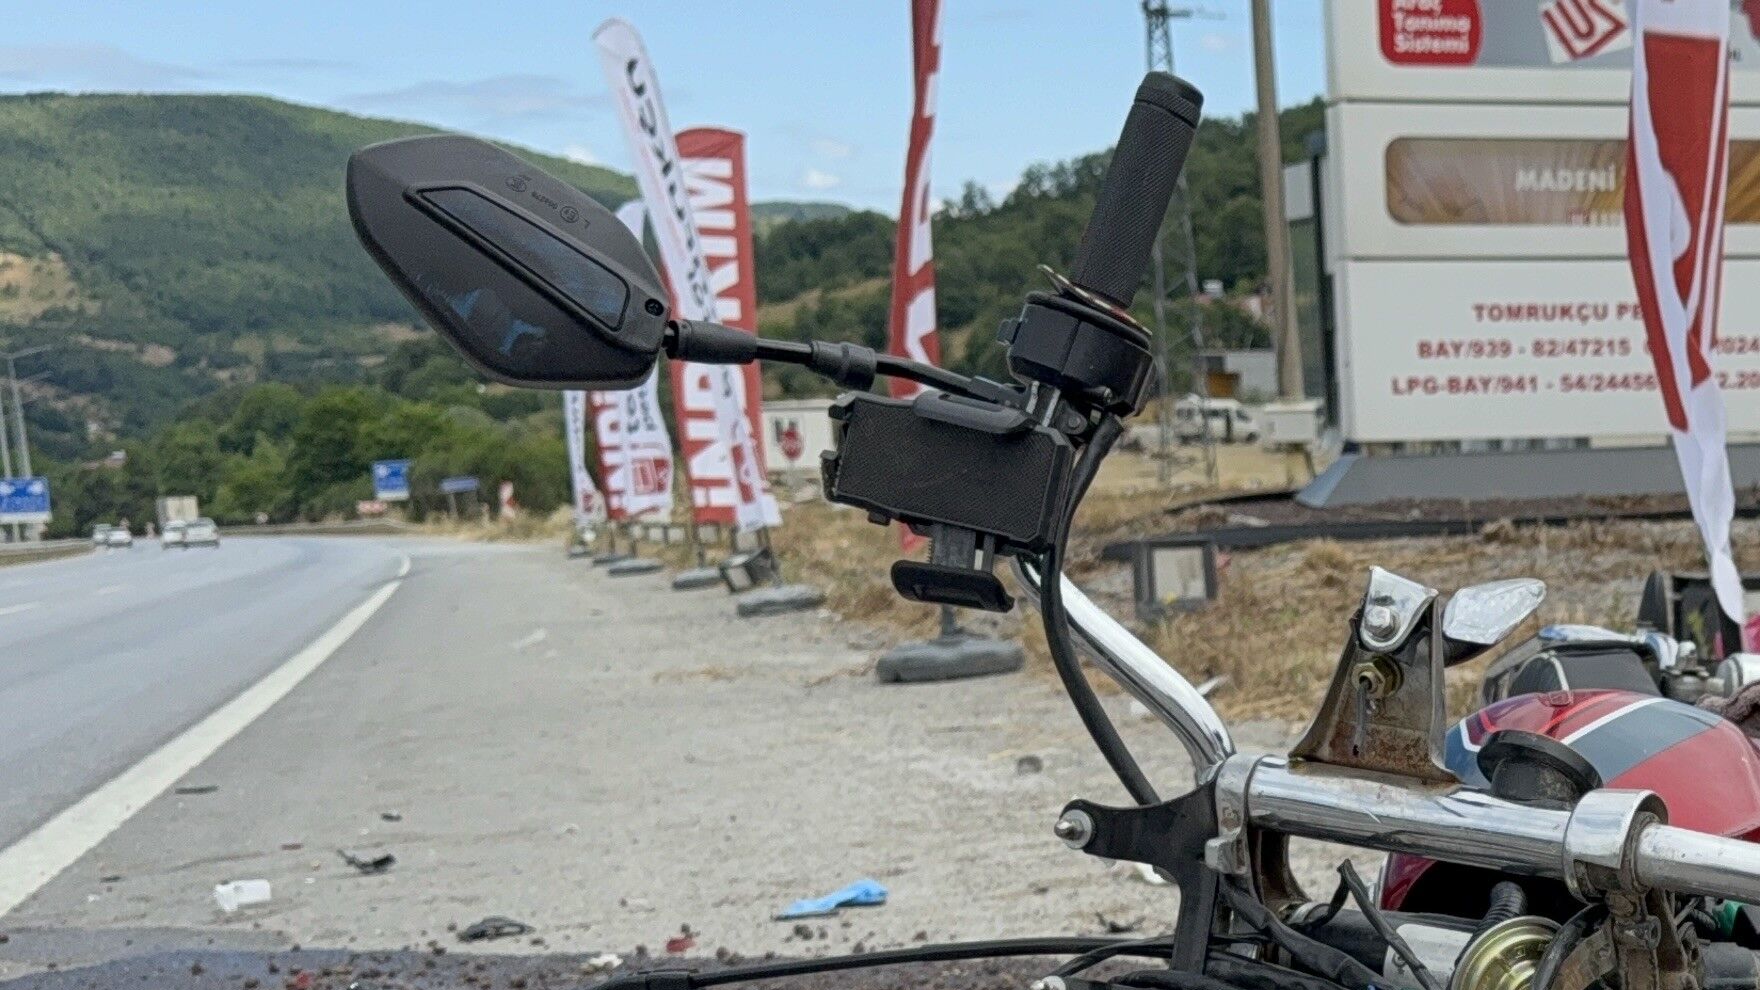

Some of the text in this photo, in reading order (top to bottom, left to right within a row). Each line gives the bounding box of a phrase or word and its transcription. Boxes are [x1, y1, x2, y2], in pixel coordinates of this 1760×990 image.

[1515, 163, 1616, 192] MADENİ
[1472, 303, 1609, 325] TOMRUKÇU
[1418, 338, 1513, 359] BAY/939
[1391, 374, 1538, 395] LPG-BAY/941
